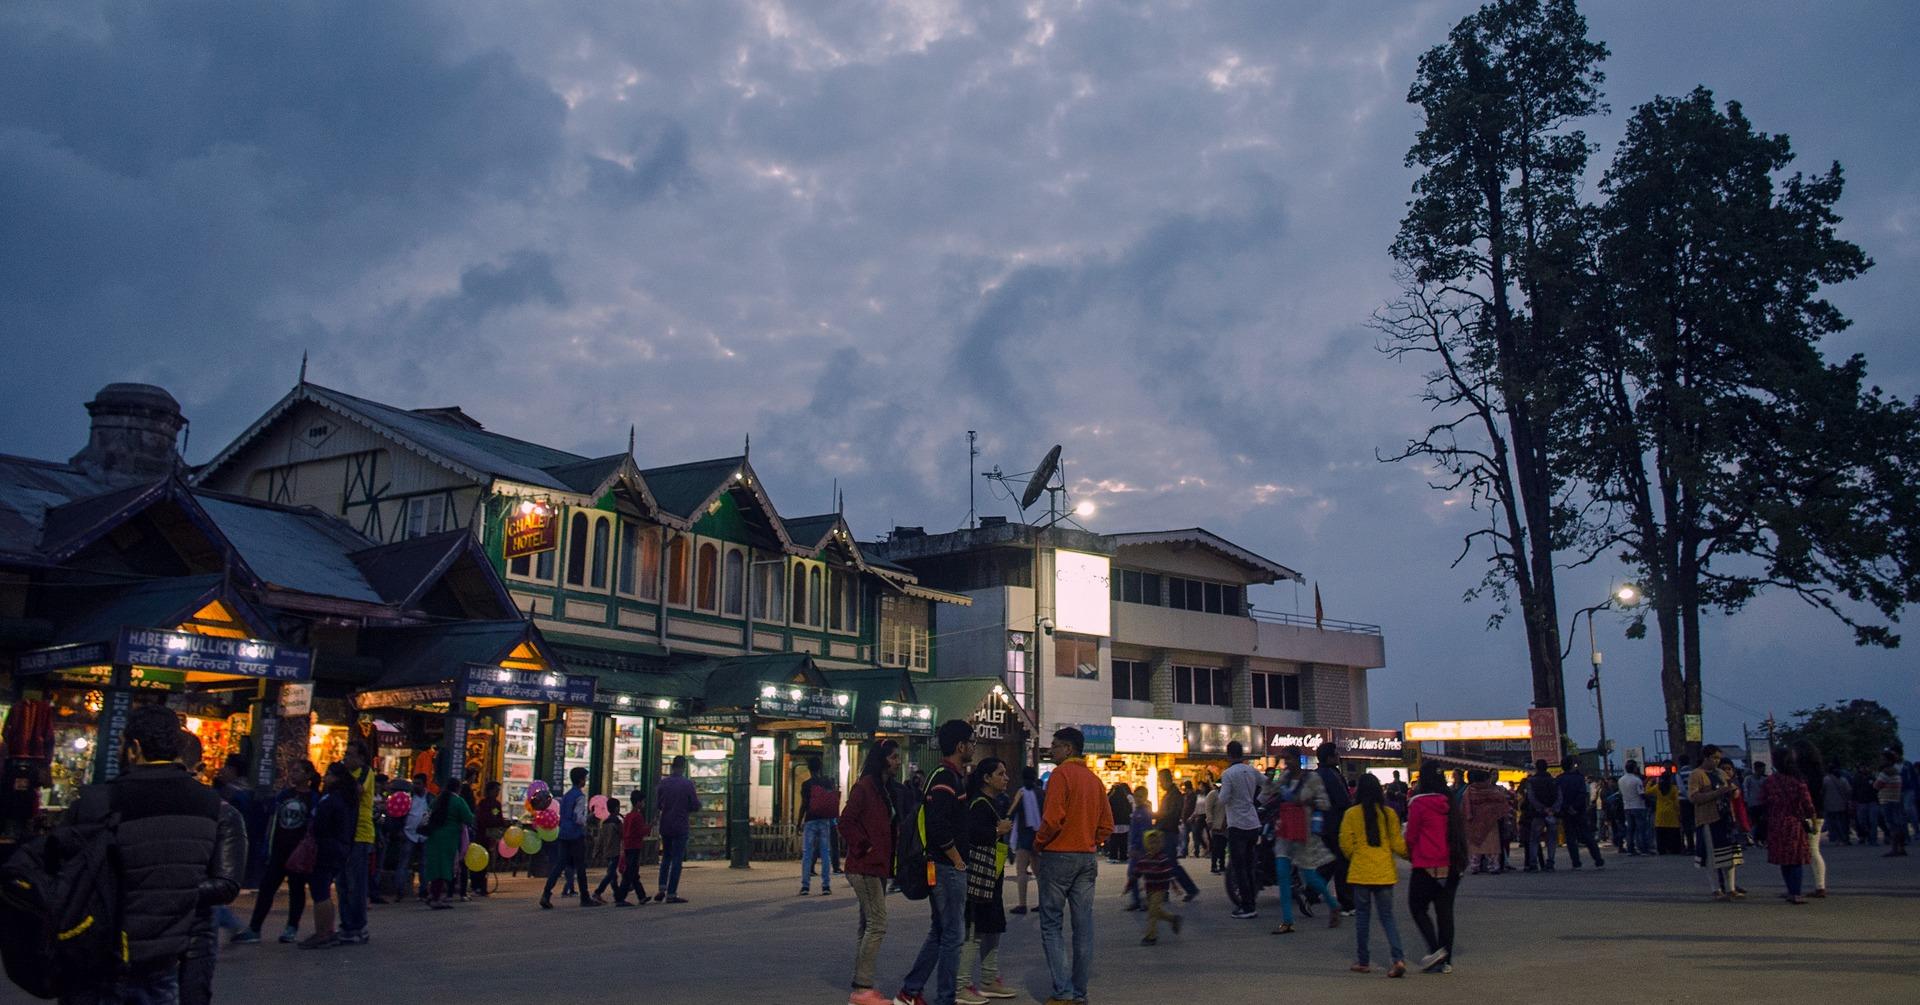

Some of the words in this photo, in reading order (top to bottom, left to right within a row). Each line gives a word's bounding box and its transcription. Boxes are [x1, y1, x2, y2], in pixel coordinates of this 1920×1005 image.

[509, 511, 552, 537] CHALET
[513, 532, 547, 551] HOTEL
[129, 632, 173, 649] HABEE
[470, 668, 502, 681] HABEE
[974, 709, 1006, 723] HALET
